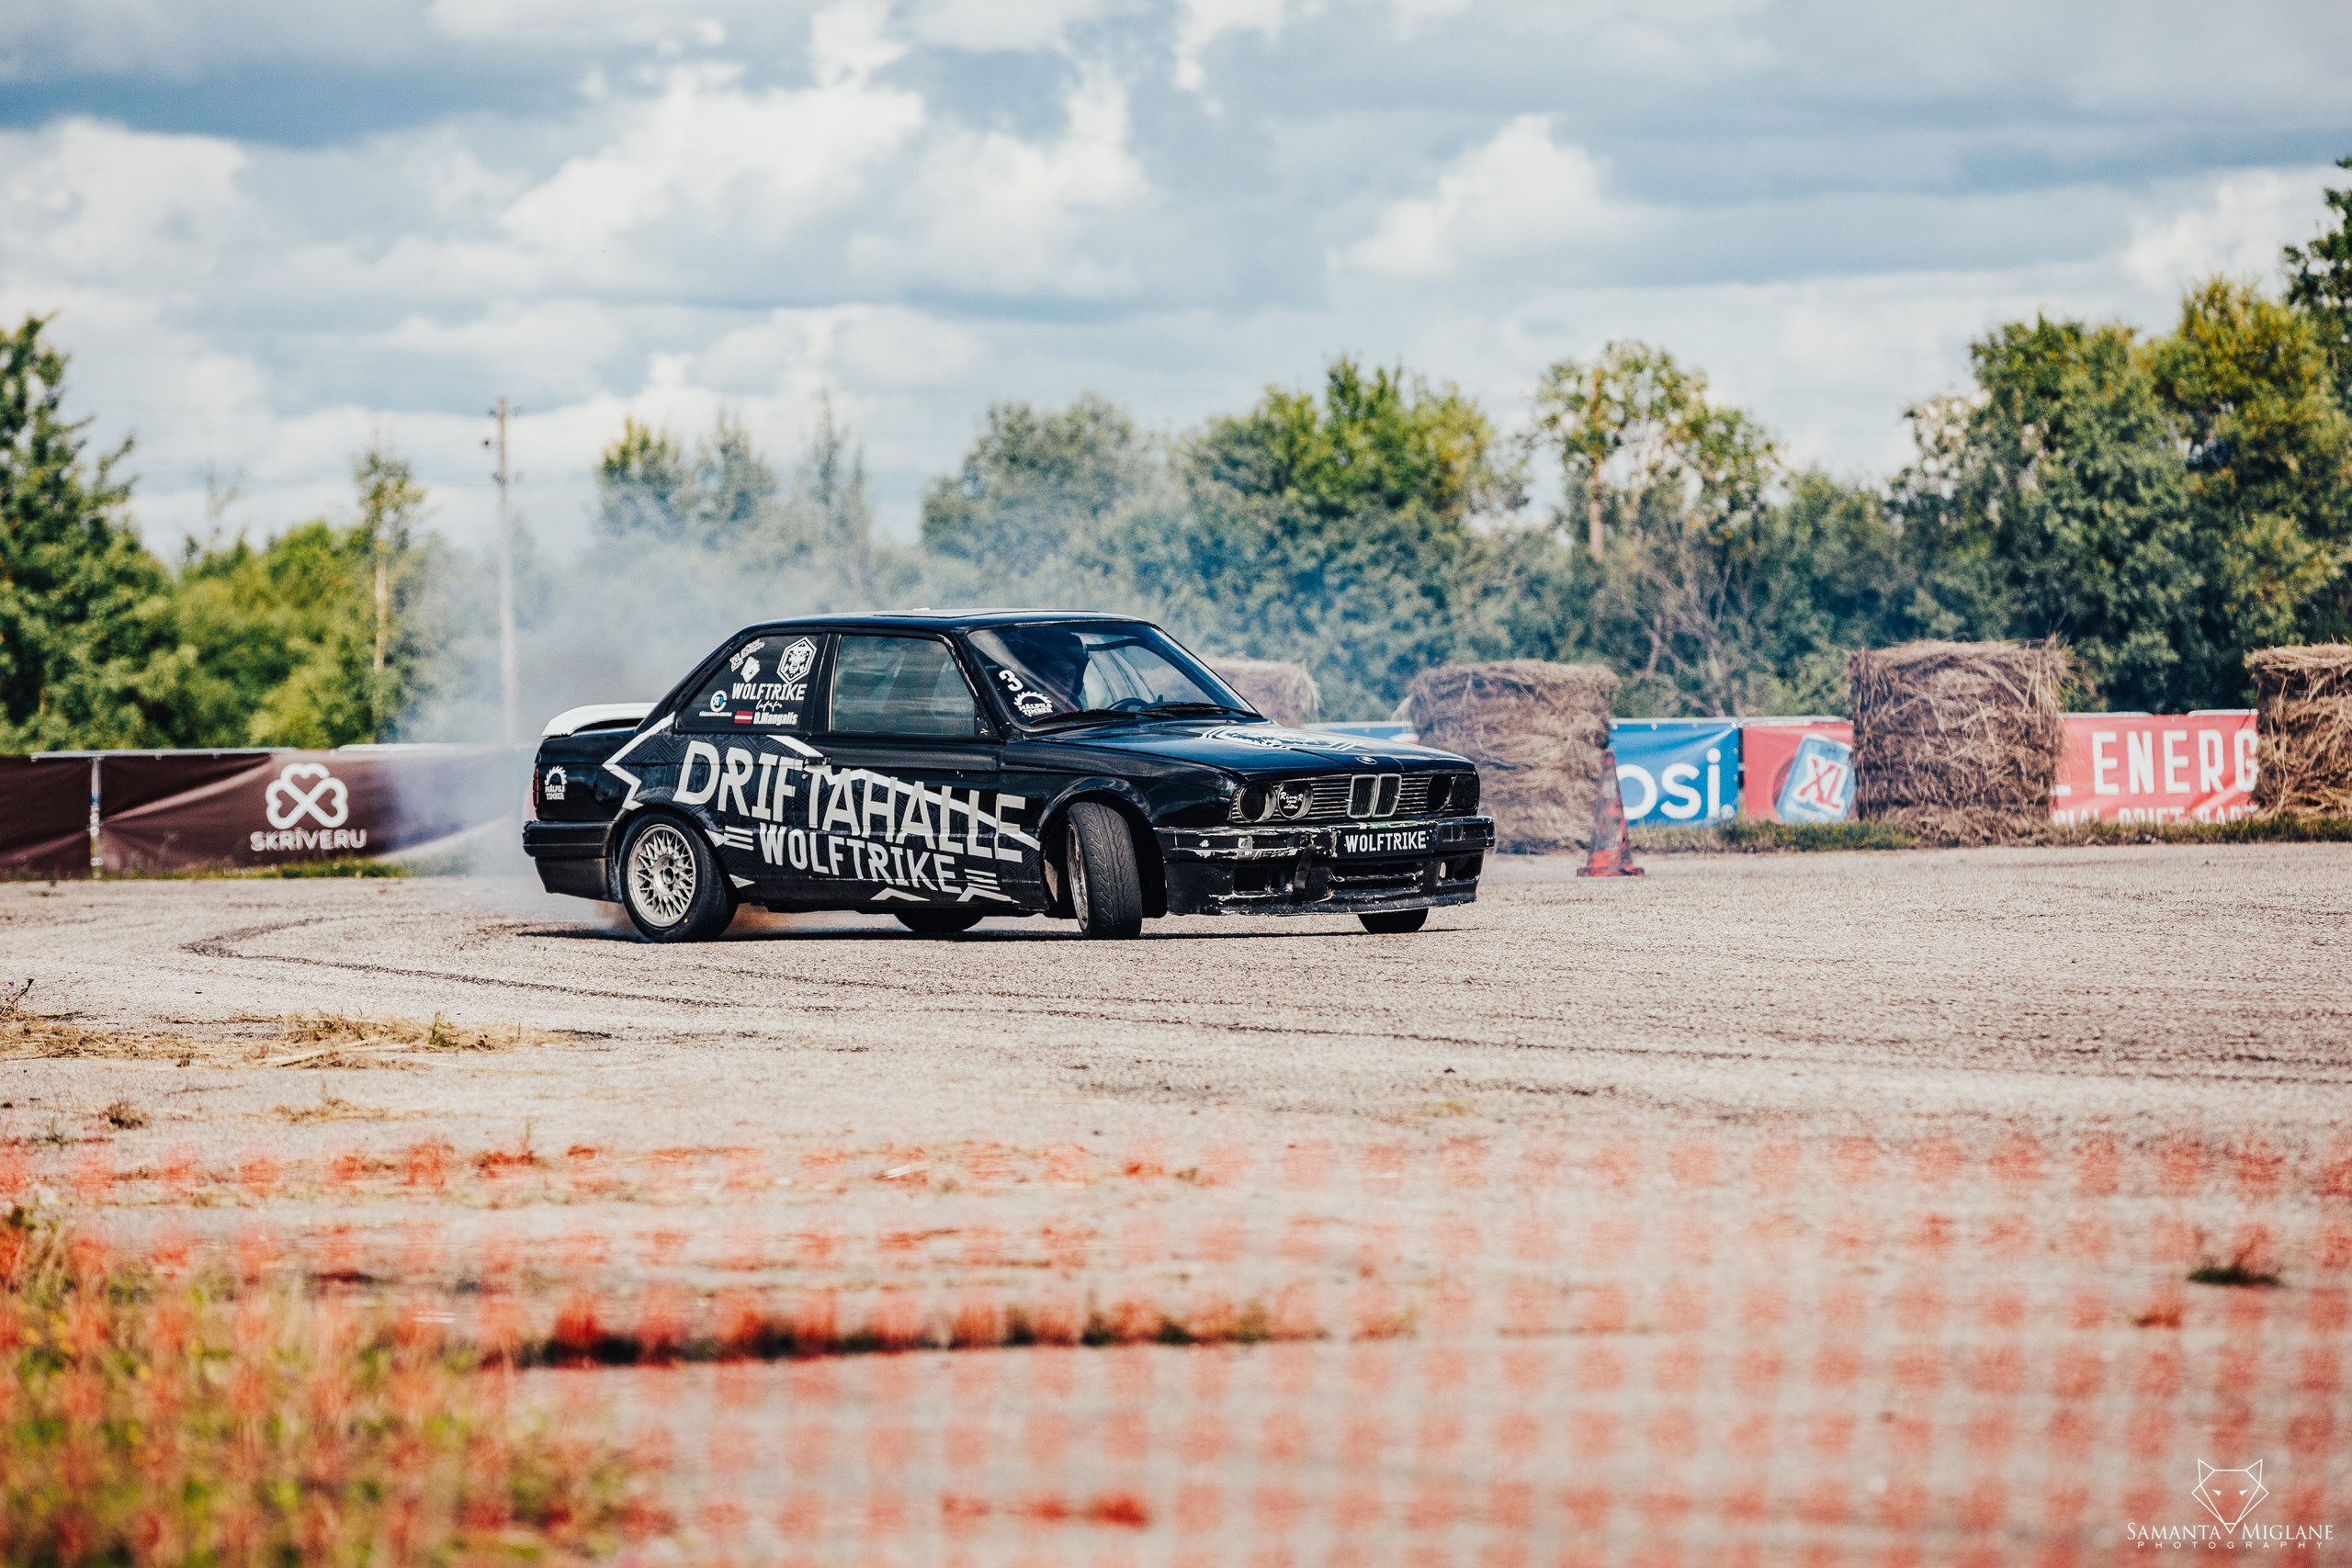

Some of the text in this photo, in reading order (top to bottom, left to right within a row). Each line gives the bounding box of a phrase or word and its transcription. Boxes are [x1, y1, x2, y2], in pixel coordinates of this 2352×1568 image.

[731, 682, 808, 701] WOLFTRIKE
[999, 670, 1023, 692] 3
[673, 740, 1025, 863] DRIFTAHALLE
[1796, 756, 1844, 812] XL
[759, 822, 963, 894] WOLFTRIKE
[1345, 830, 1426, 852] WOLFTRIKE
